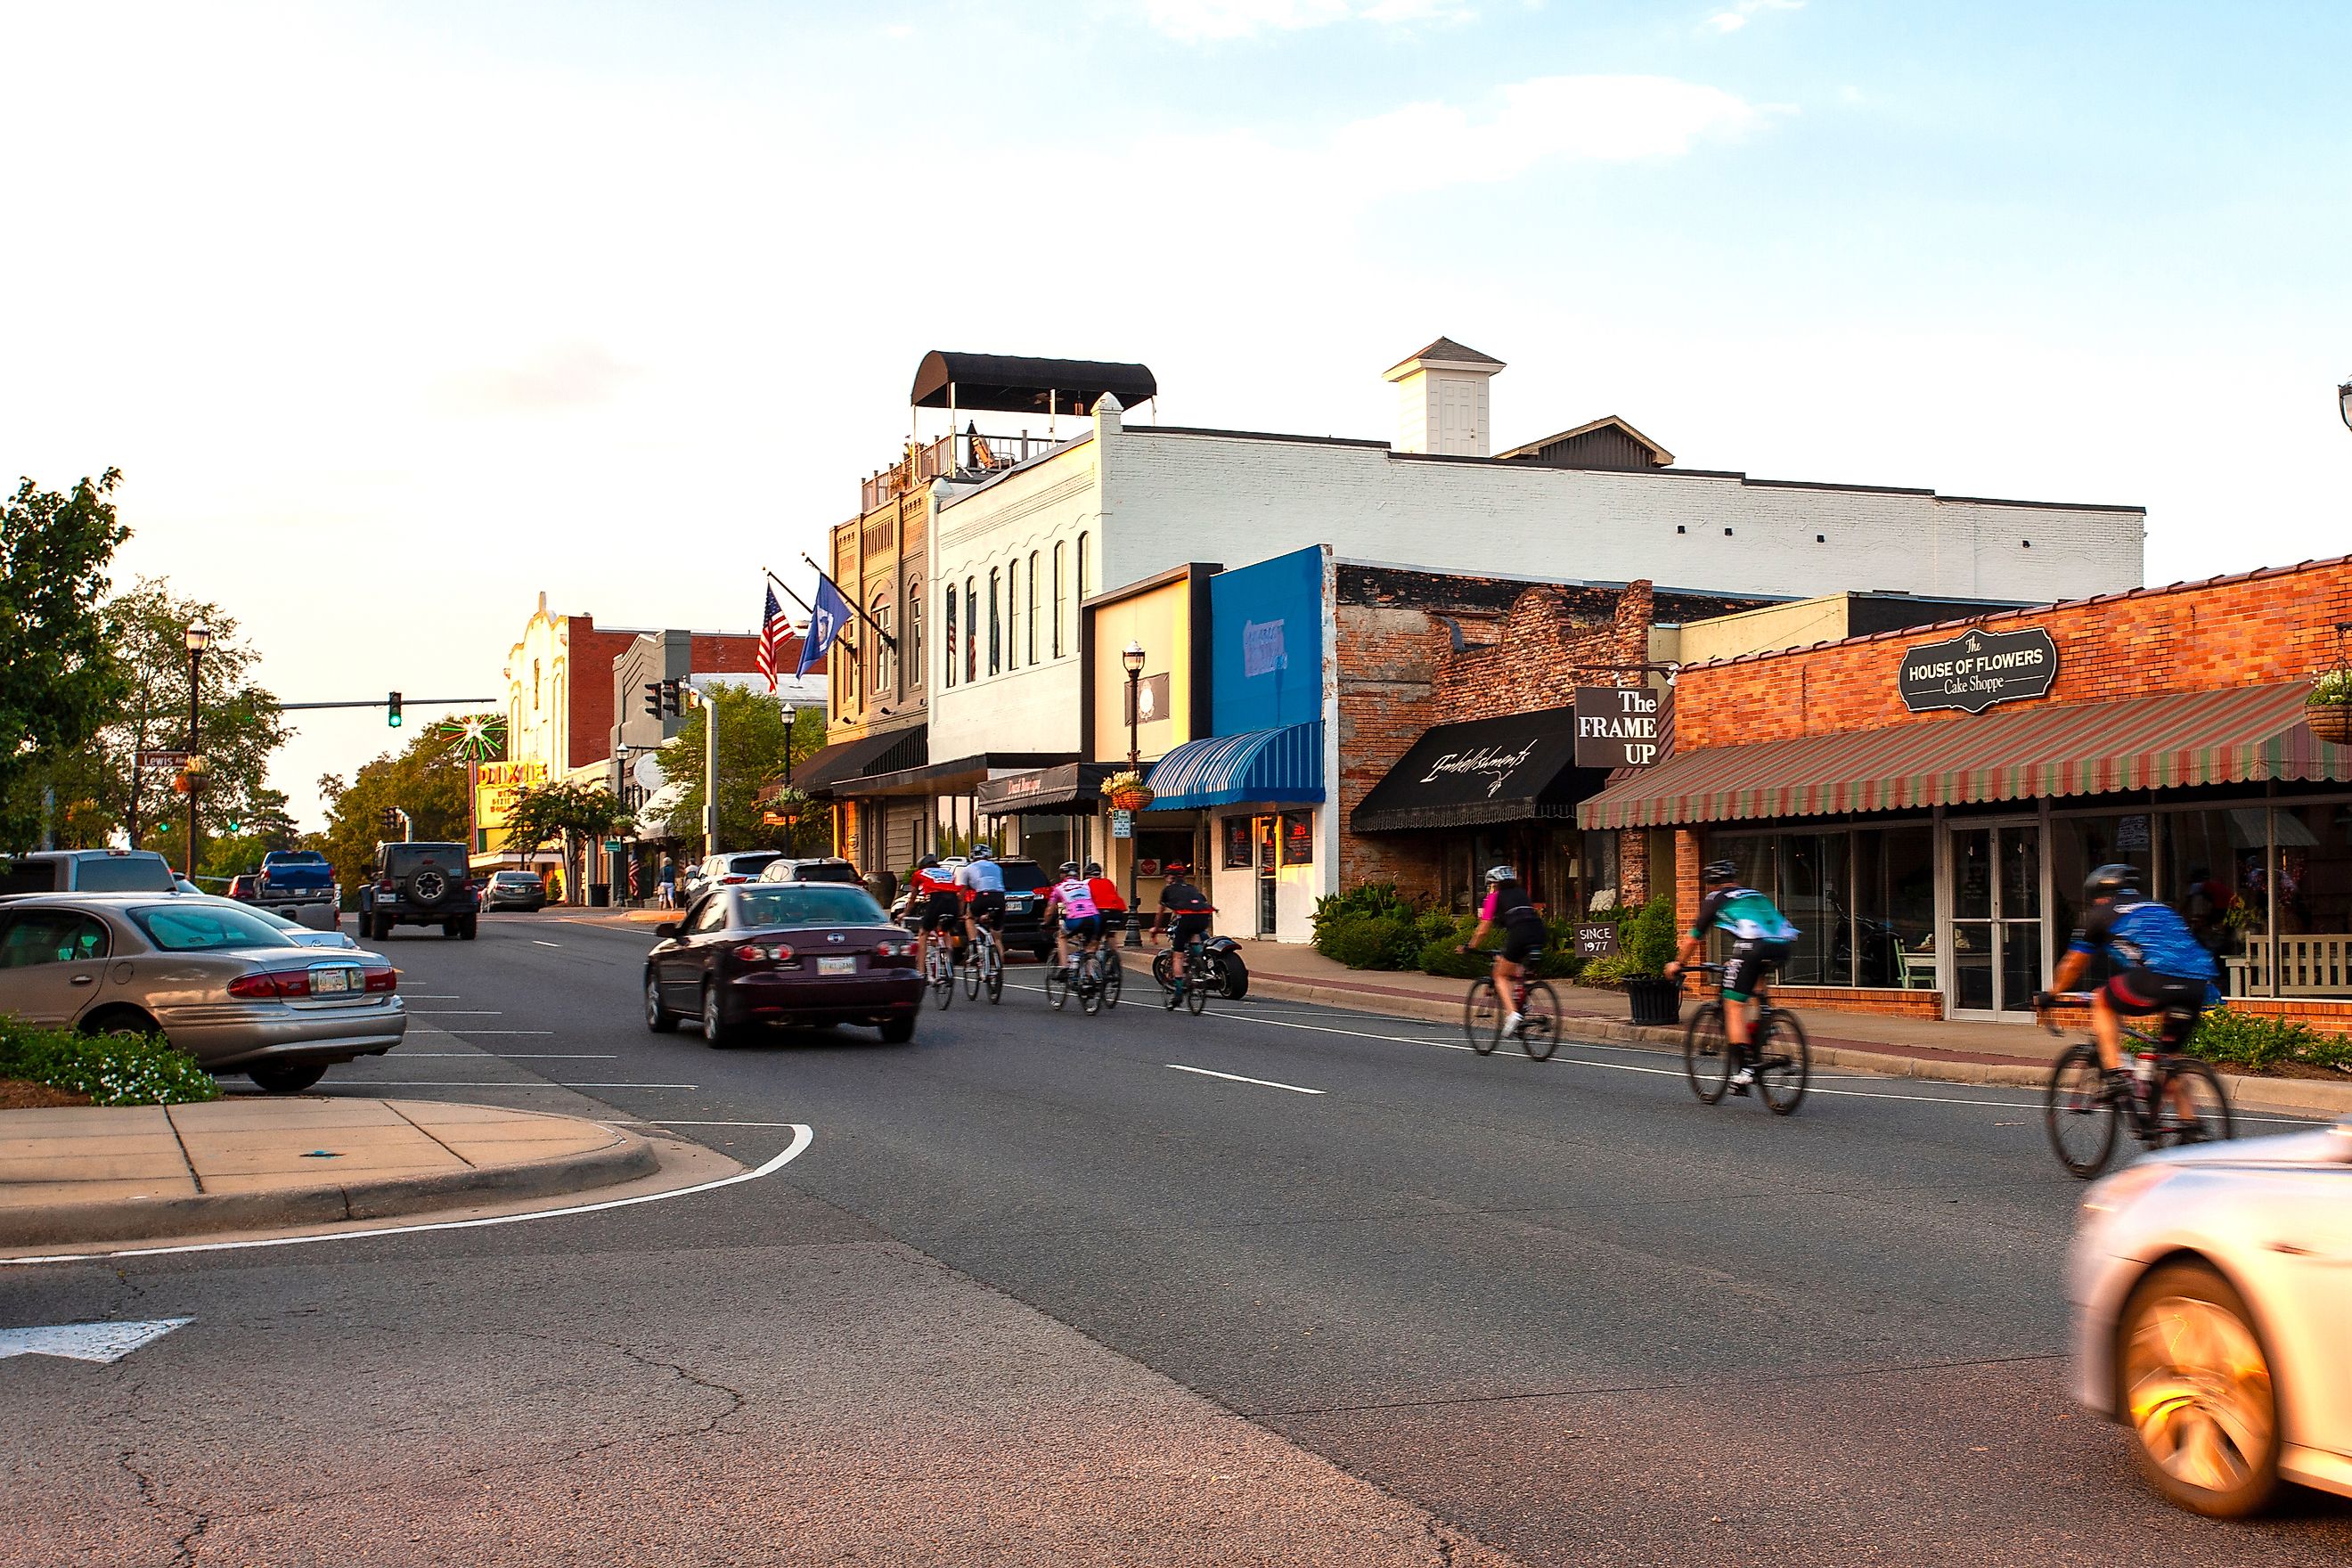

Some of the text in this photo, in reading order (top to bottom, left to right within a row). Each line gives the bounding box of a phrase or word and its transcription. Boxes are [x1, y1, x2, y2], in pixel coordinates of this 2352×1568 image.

[1965, 635, 1981, 653] The
[1909, 648, 2044, 681] HOUSE OF FLOWERS
[1944, 674, 2005, 695] Cake Shoppe
[1618, 690, 1657, 713] The
[1578, 716, 1657, 738] FRAME
[144, 754, 173, 766] Lewis
[1419, 739, 1538, 782] Embellishments
[1624, 744, 1656, 764] UP
[477, 764, 547, 785] DIXIE
[1580, 927, 1612, 940] SINCE
[1584, 941, 1608, 952] 1977
